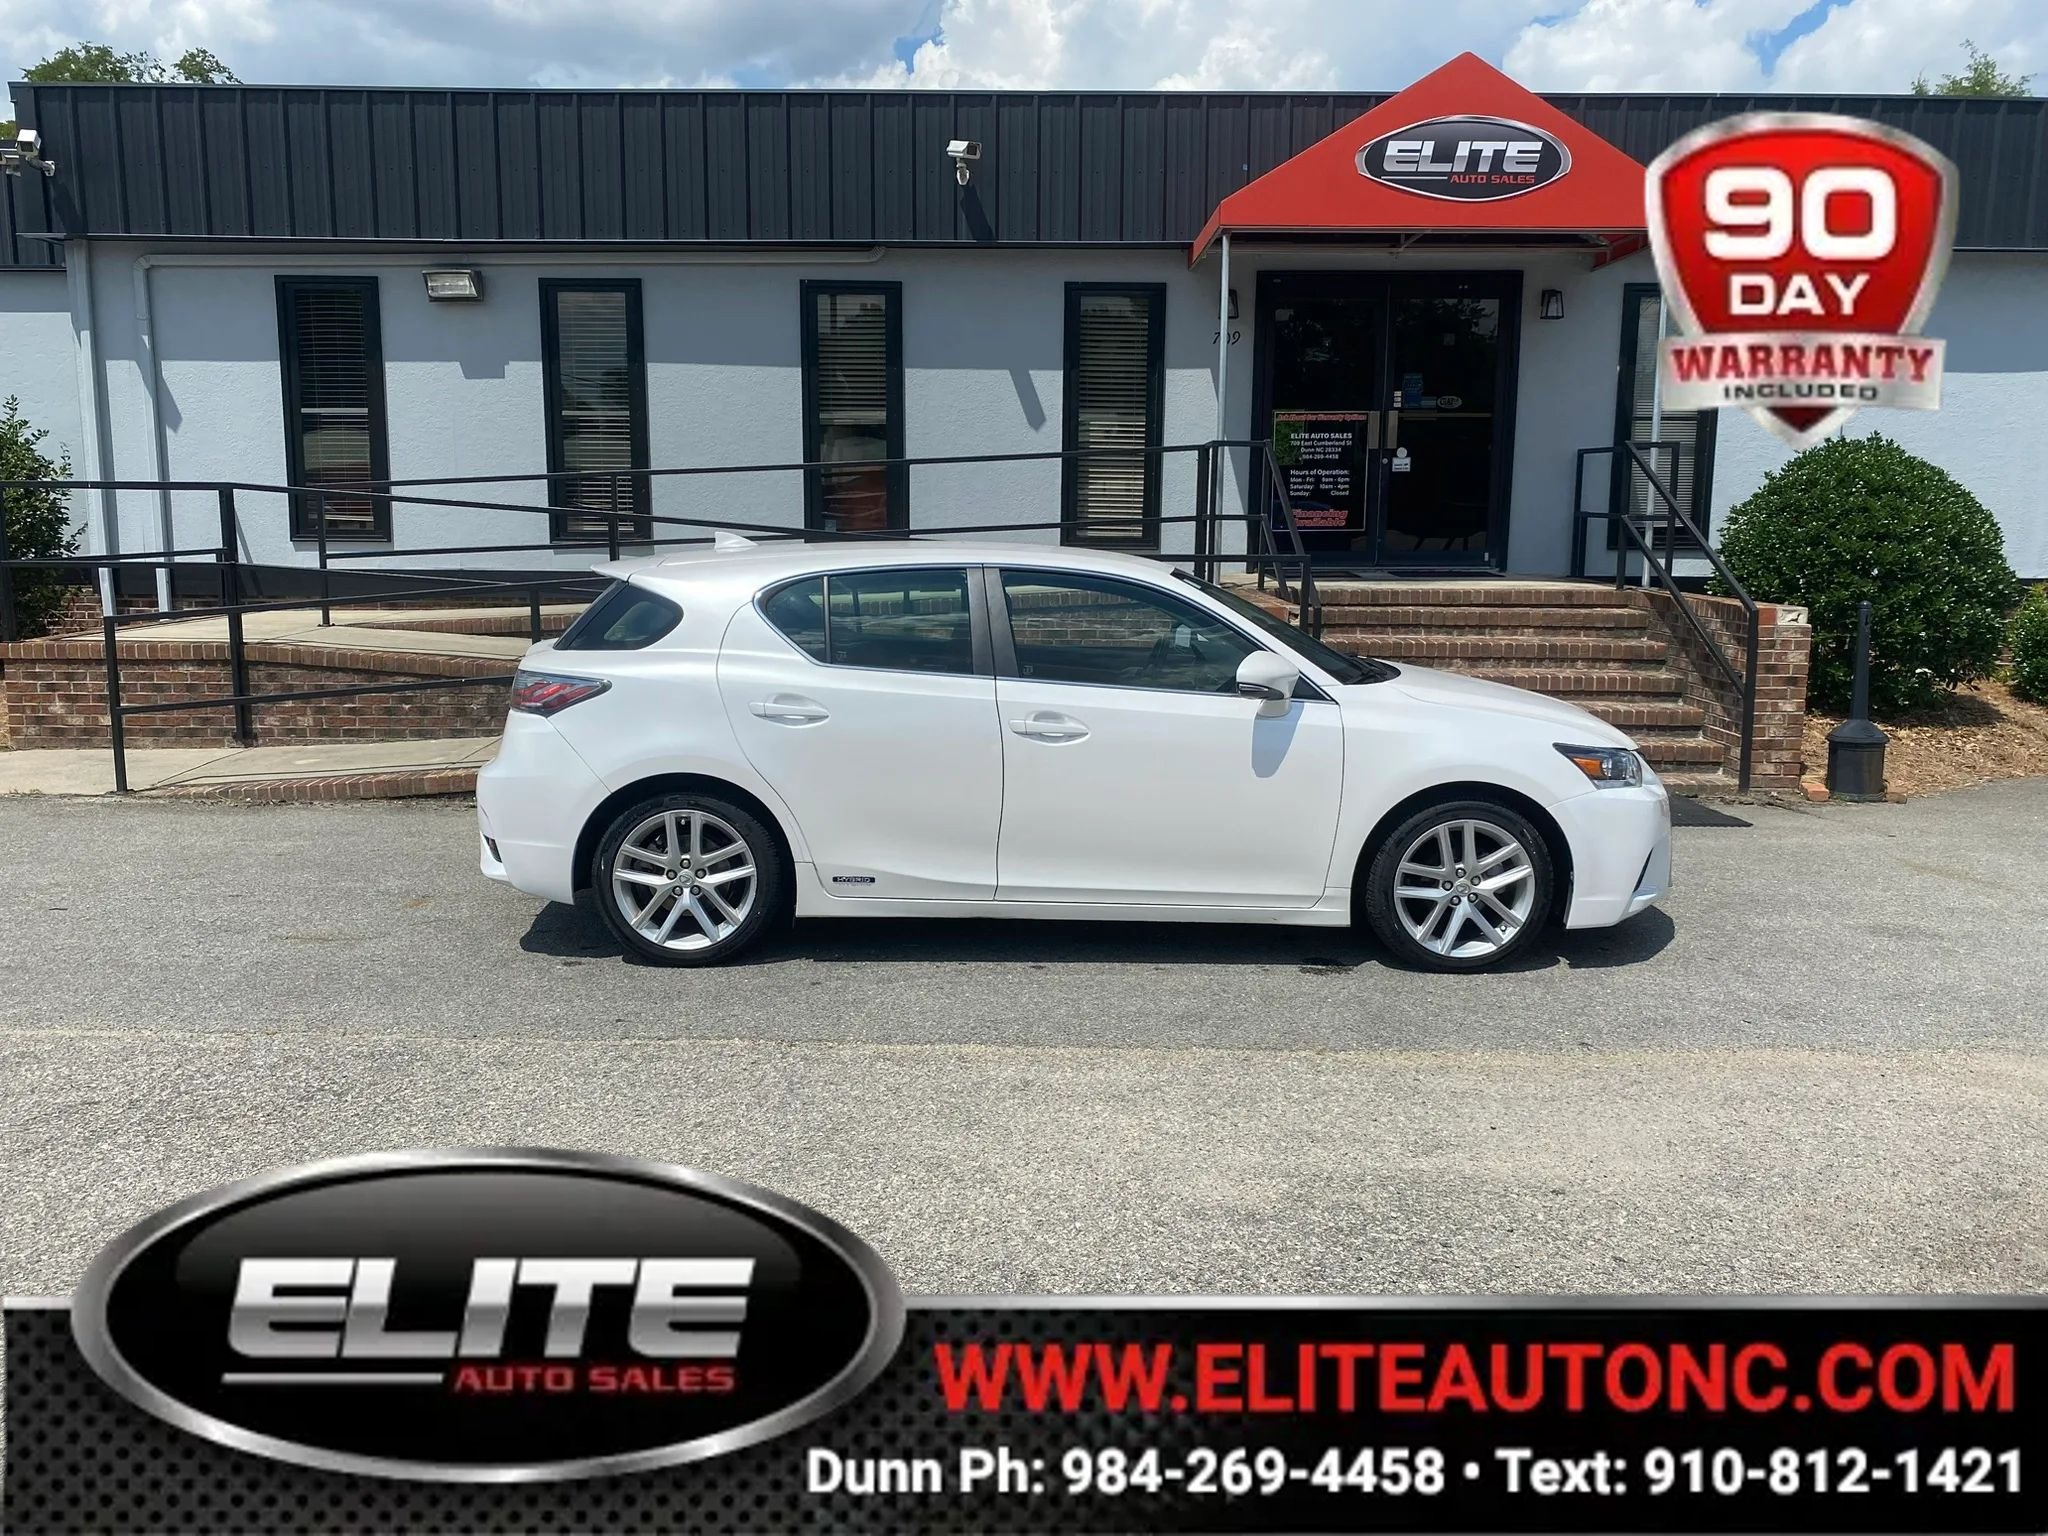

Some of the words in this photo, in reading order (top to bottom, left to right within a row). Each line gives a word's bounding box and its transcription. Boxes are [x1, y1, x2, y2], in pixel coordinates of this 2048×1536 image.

[1382, 140, 1543, 173] ELITE
[1450, 175, 1487, 184] AUTO
[1491, 175, 1535, 184] SALES
